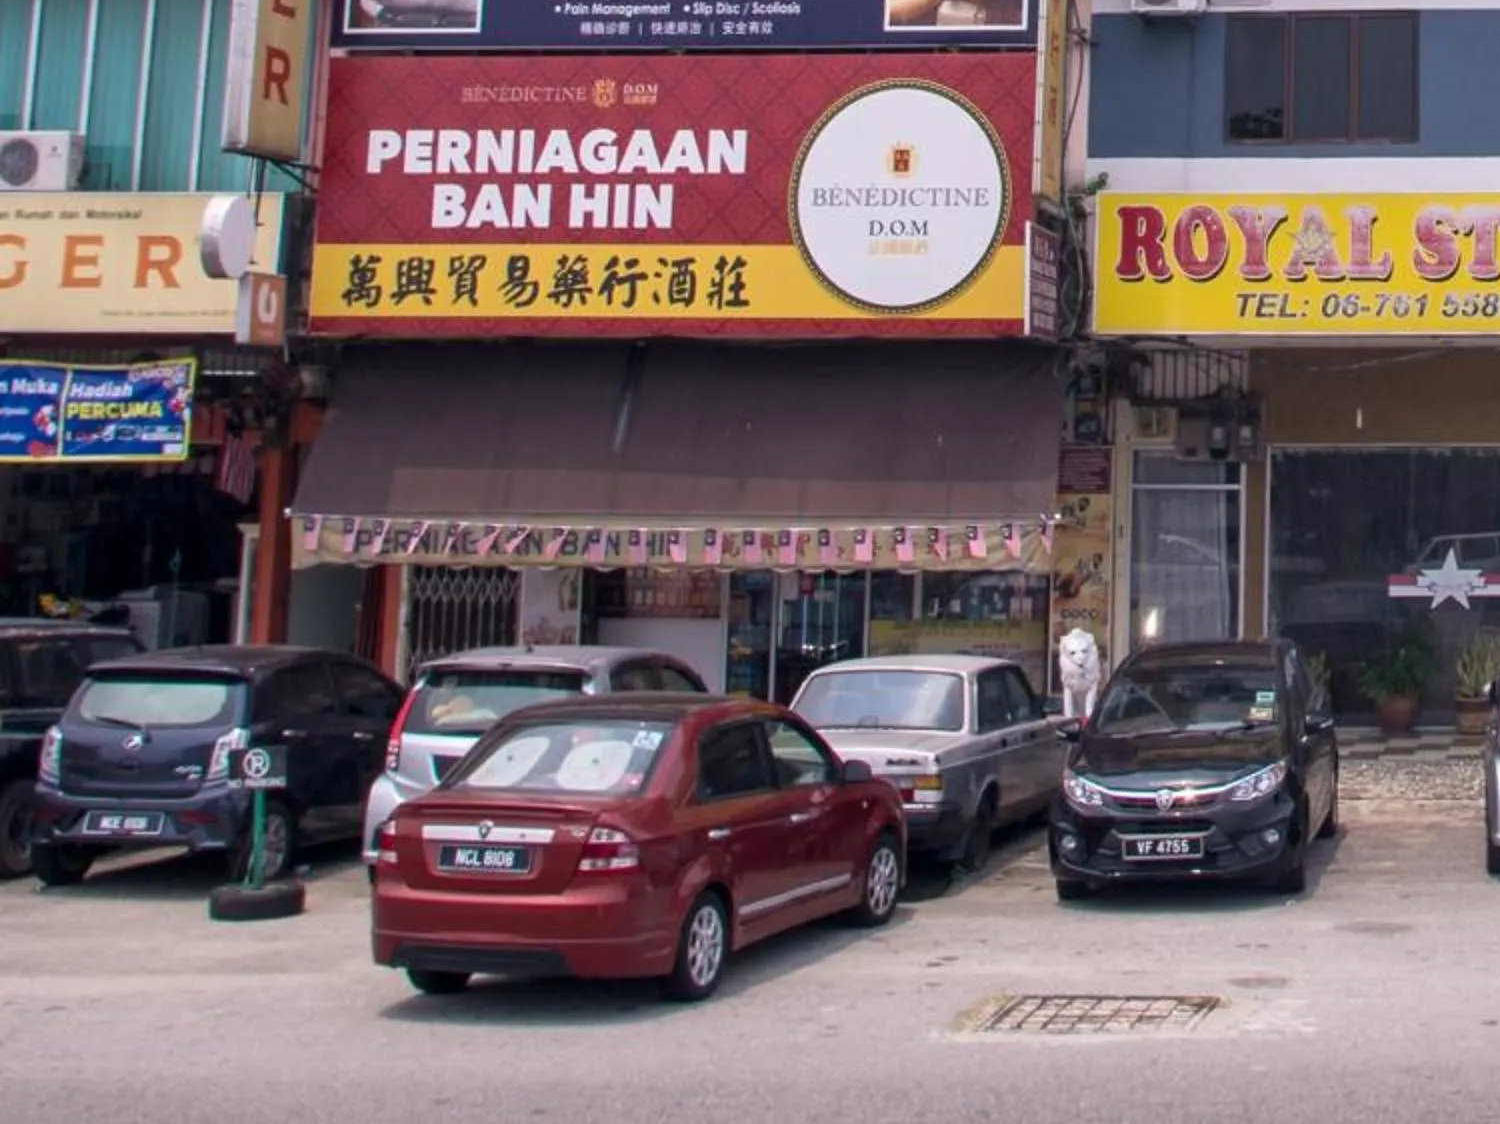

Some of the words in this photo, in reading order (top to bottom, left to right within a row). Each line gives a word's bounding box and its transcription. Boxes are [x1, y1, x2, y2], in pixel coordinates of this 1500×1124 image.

[564, 3, 590, 15] Pain
[592, 2, 671, 17] Management
[692, 2, 713, 16] Slip
[716, 2, 740, 15] Disc
[366, 128, 748, 175] PERNIAGAAN
[811, 183, 990, 208] BÉNÉDICTINE
[430, 182, 552, 230] BAN
[568, 182, 674, 230] HIN
[868, 220, 929, 236] D.O.M
[1115, 204, 1394, 283] ROYAL
[0, 234, 183, 289] GER
[341, 254, 750, 311] 萬興貿易藥行酒莊
[1236, 293, 1309, 318] TEL:
[1321, 292, 1429, 318] 06-761
[11, 378, 59, 394] Muka
[70, 381, 134, 397] Hadiah
[66, 401, 164, 419] PERCUMA
[1137, 840, 1153, 854] VF
[1156, 839, 1189, 853] 4755
[455, 847, 481, 866] NCL
